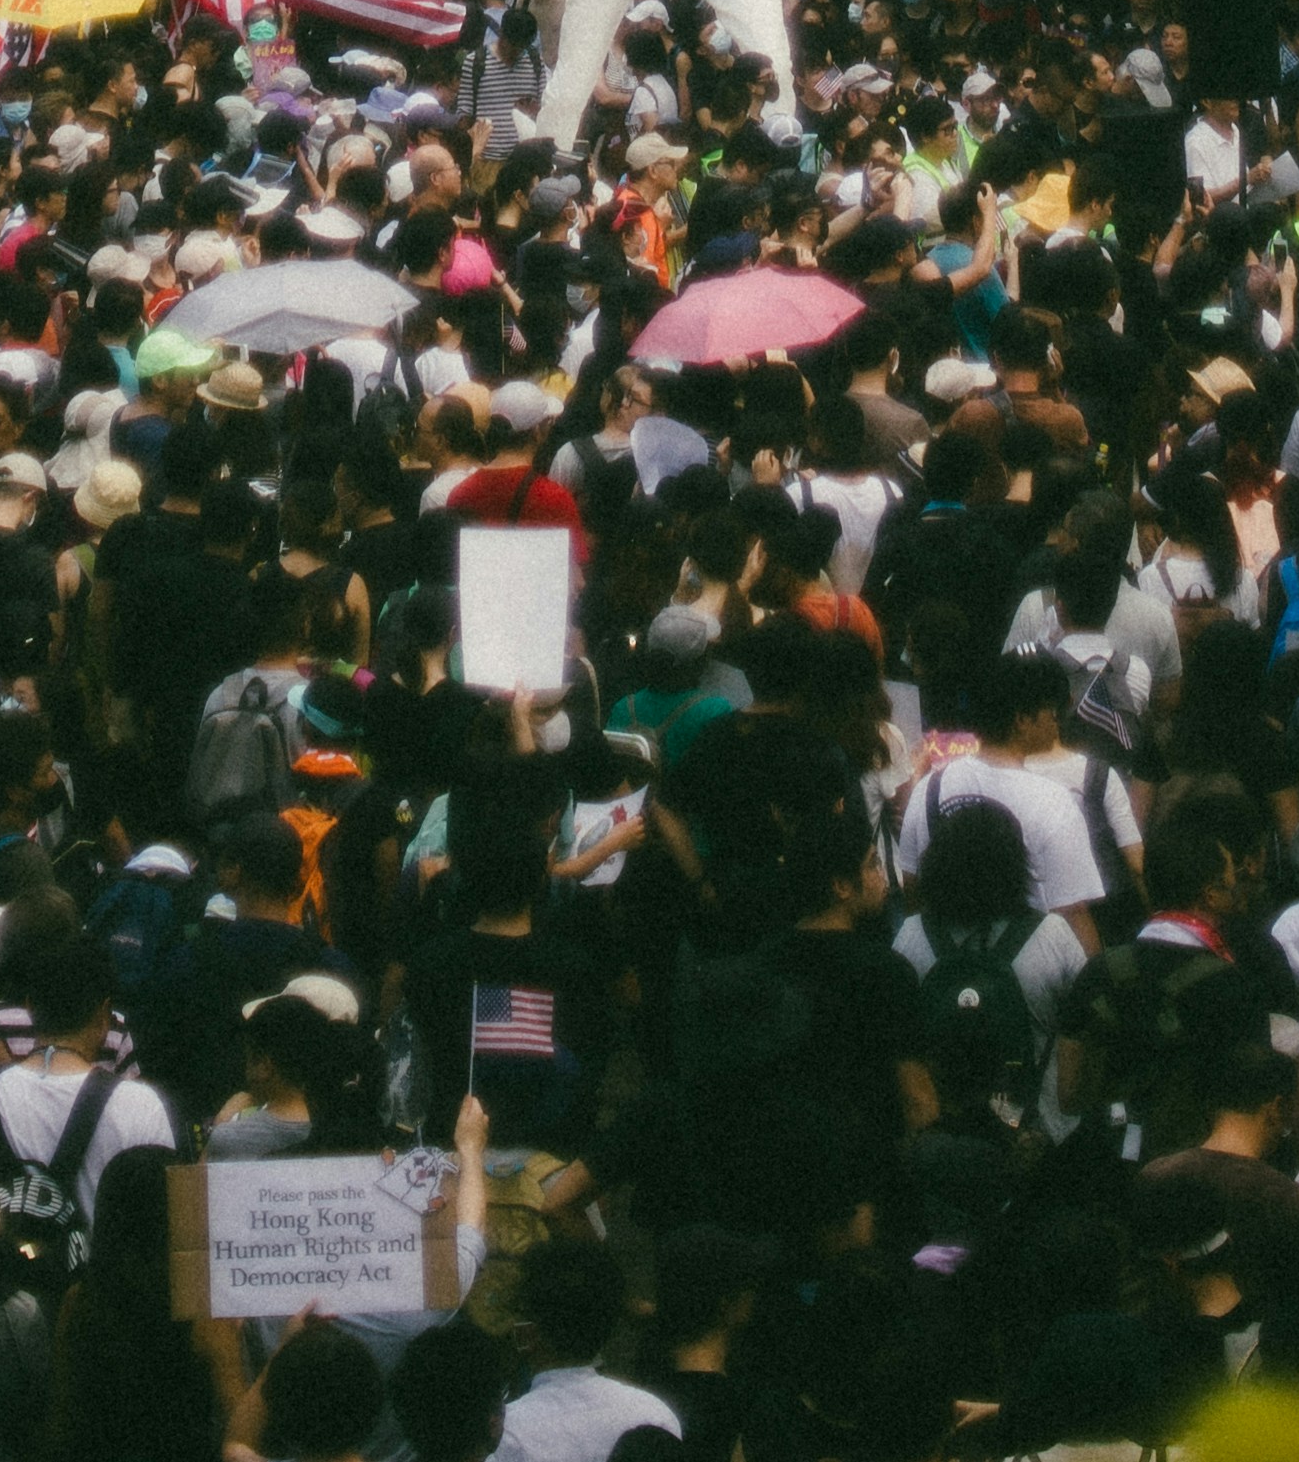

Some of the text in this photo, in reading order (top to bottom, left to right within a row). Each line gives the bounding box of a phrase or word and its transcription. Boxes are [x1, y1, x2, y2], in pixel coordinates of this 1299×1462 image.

[258, 1186, 366, 1205] Please pass the
[251, 1208, 375, 1236] Hong Kong
[214, 1234, 415, 1263] Human Rights and
[231, 1263, 392, 1290] Democracy Act
